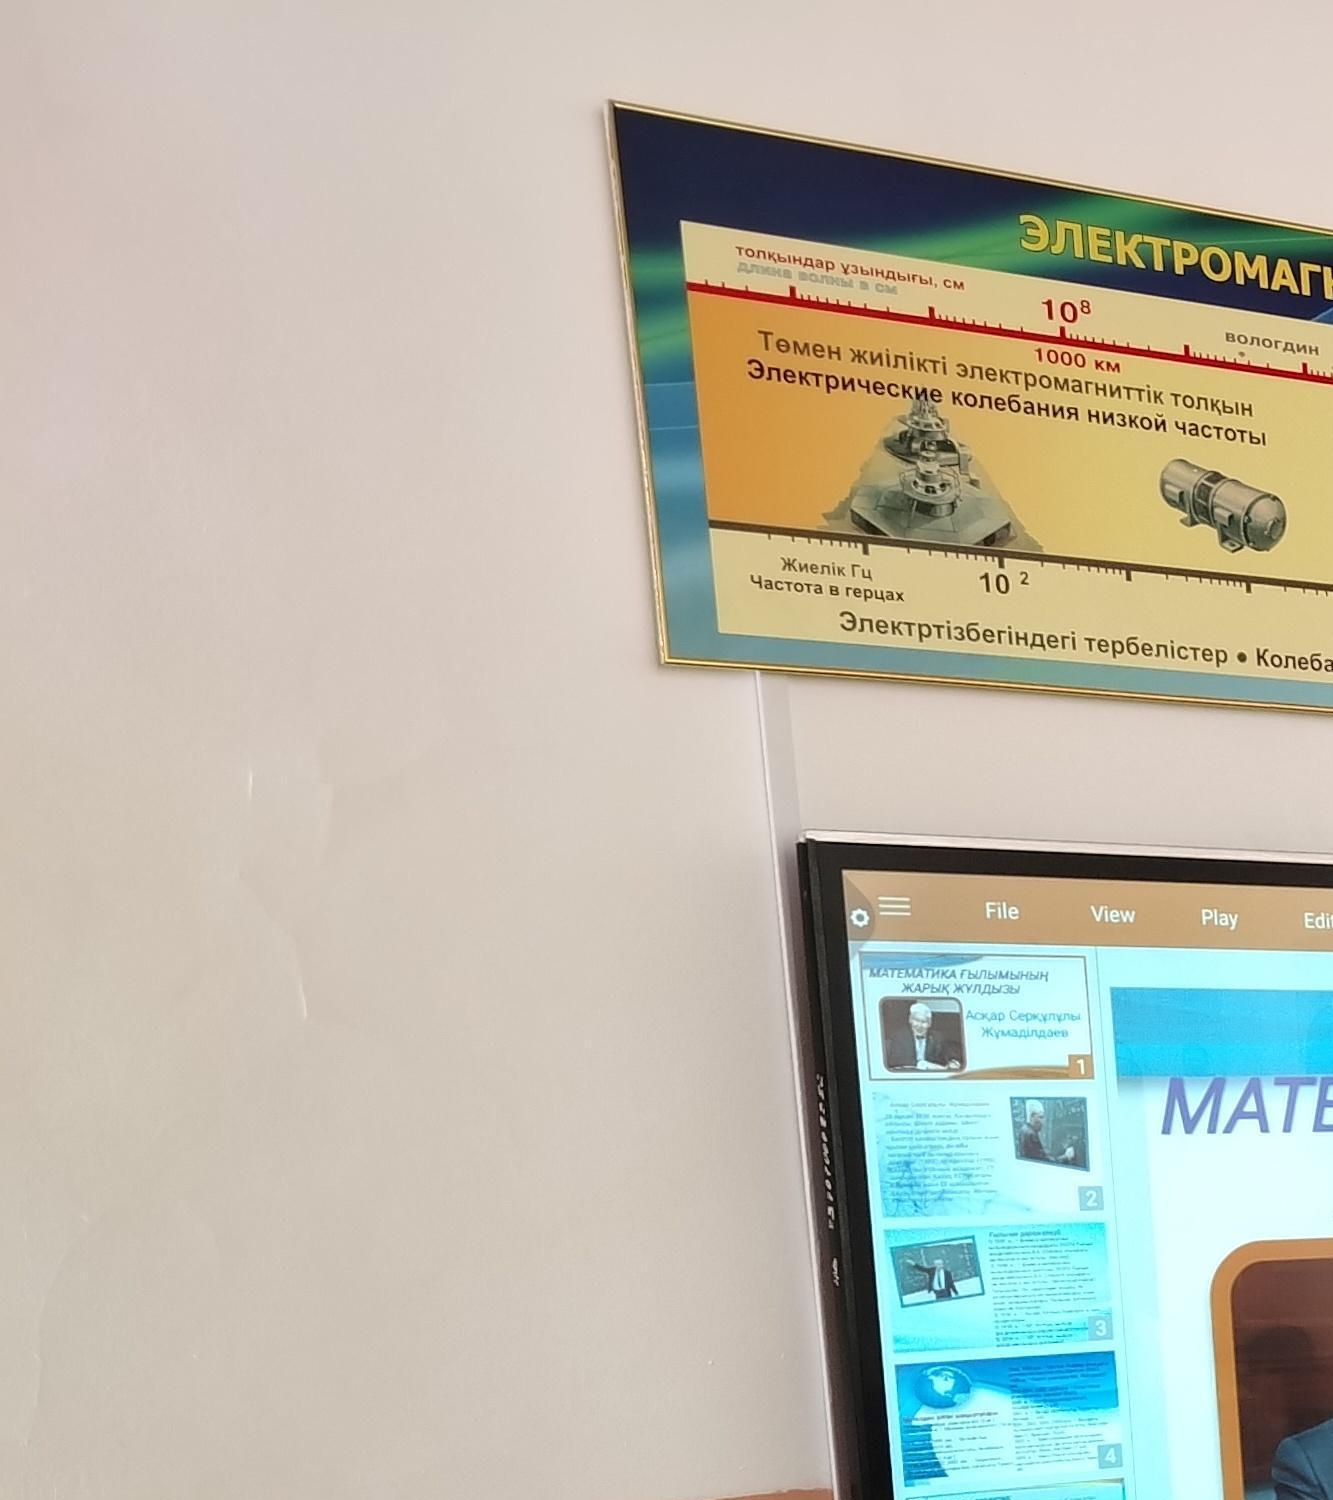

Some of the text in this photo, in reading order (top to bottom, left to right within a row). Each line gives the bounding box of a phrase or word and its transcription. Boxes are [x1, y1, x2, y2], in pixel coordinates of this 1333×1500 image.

[735, 246, 835, 272] толқындар
[943, 278, 965, 291] см
[1033, 347, 1121, 373] 1000 км
[758, 330, 1254, 419] Төмен жиілікті электромагниттік толқын
[746, 358, 1268, 446] Электрические колебания низкой частоты
[780, 556, 873, 581] Жиелік Гц
[749, 574, 905, 603] Частота в герцах
[839, 610, 1078, 652] Электртізбегіндегі
[1083, 634, 1228, 665] тербелістер
[985, 902, 1019, 921] File
[1090, 904, 1135, 924] View
[1201, 908, 1239, 930] Play
[1076, 1059, 1086, 1075] 1
[1086, 1190, 1098, 1206] 2
[1095, 1320, 1107, 1336] 3
[1104, 1448, 1116, 1464] 4
